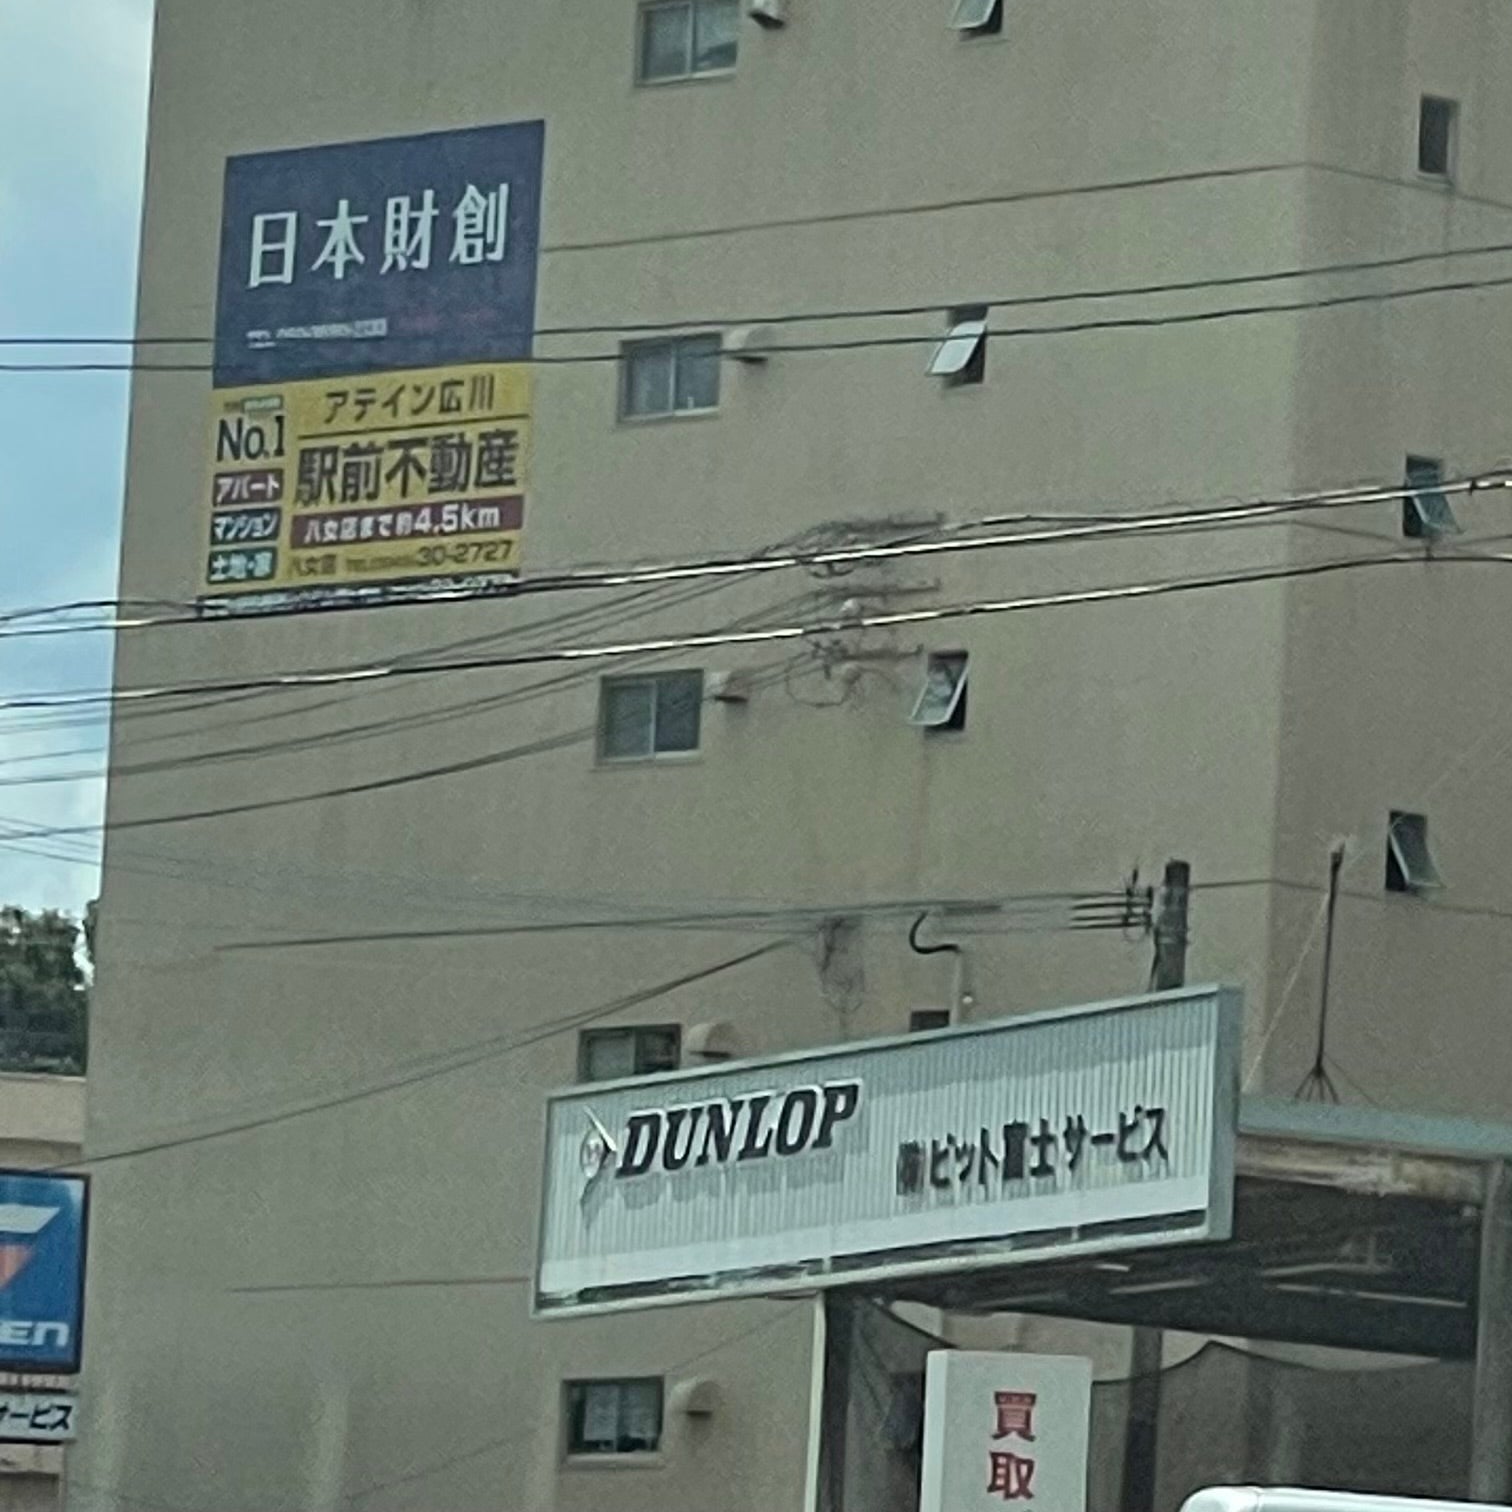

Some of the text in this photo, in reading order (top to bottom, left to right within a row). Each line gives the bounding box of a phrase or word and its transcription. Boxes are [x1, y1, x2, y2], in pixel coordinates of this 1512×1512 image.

[248, 182, 509, 288] 日本財創
[217, 473, 280, 504] アパート
[294, 429, 519, 508] 駅前不動産
[615, 1081, 861, 1179] DUNLOP
[986, 1391, 1037, 1500] 買取
